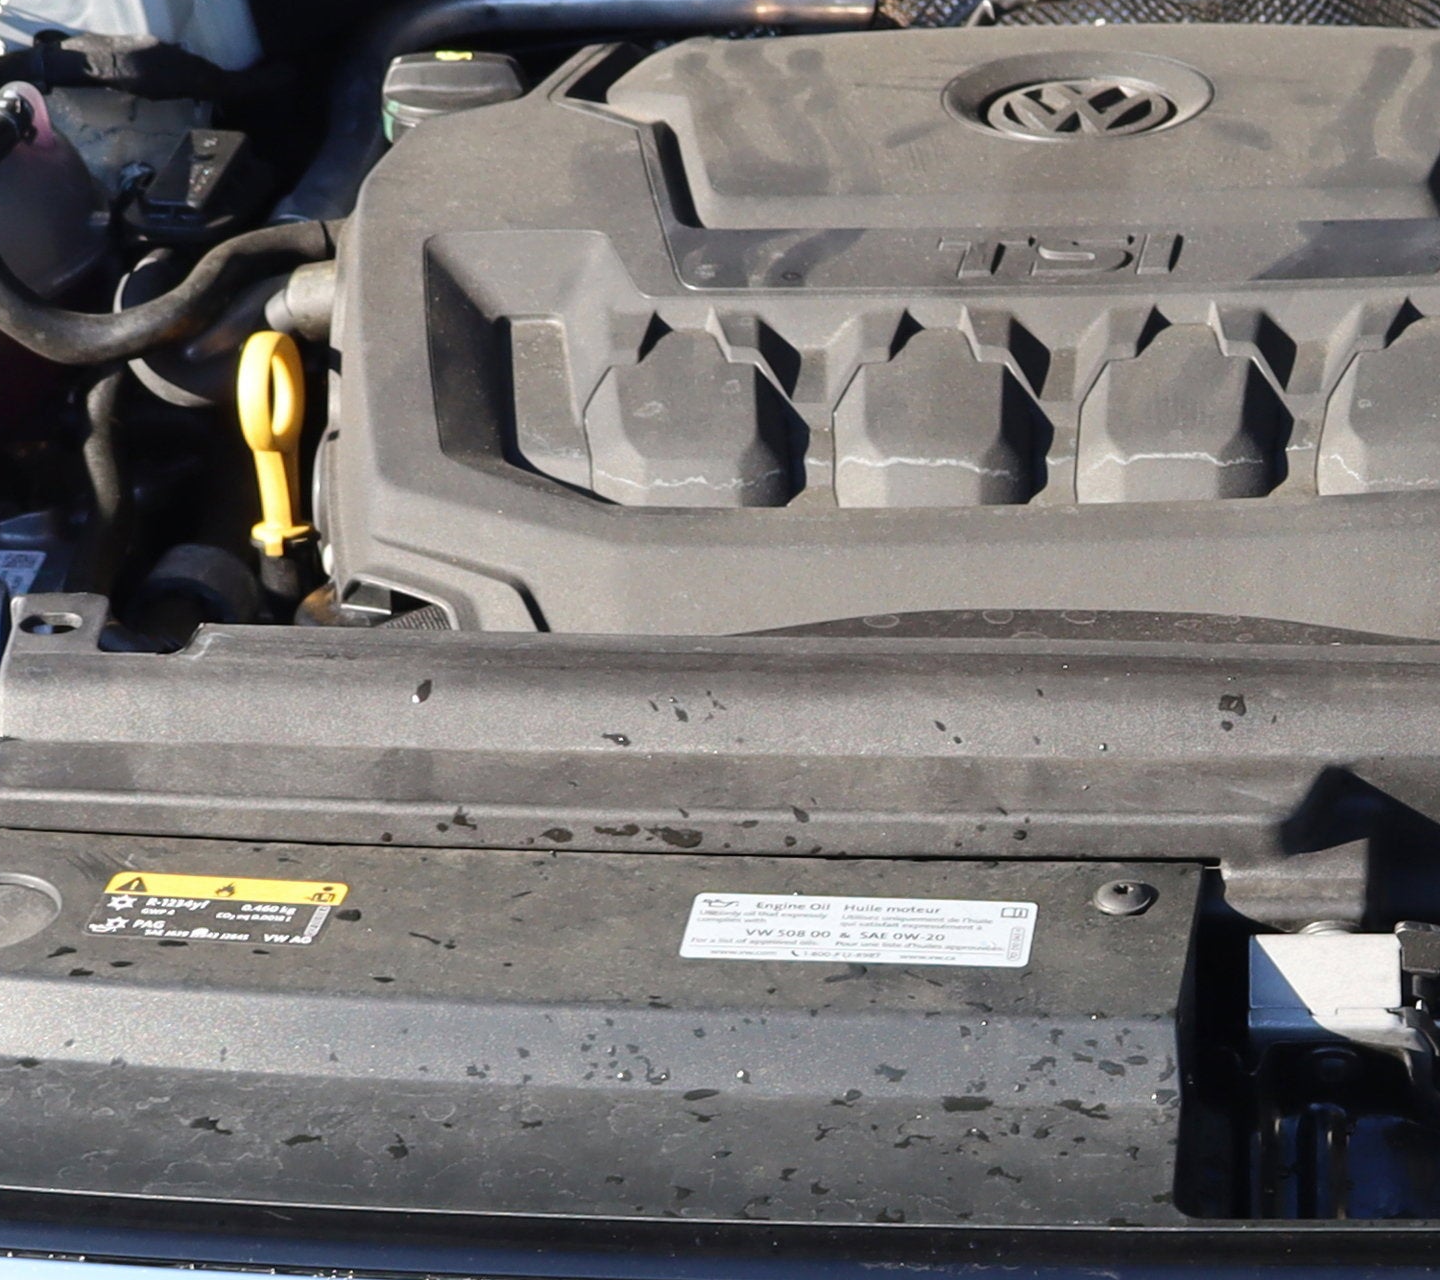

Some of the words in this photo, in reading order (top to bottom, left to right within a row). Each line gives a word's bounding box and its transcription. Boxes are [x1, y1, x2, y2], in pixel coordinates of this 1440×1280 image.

[938, 232, 1184, 278] TSI
[145, 897, 210, 910] R-1234yf
[756, 901, 806, 912] Engine
[809, 902, 832, 911] Oil
[843, 904, 882, 912] Huile
[886, 905, 941, 914] moteur
[133, 919, 166, 929] PAG
[263, 933, 290, 942] VW
[289, 935, 312, 944] AG
[745, 928, 774, 936] VW
[777, 929, 806, 937] 508
[810, 930, 831, 938] 00
[859, 931, 887, 940] SAE
[892, 931, 946, 941] 0W-20
